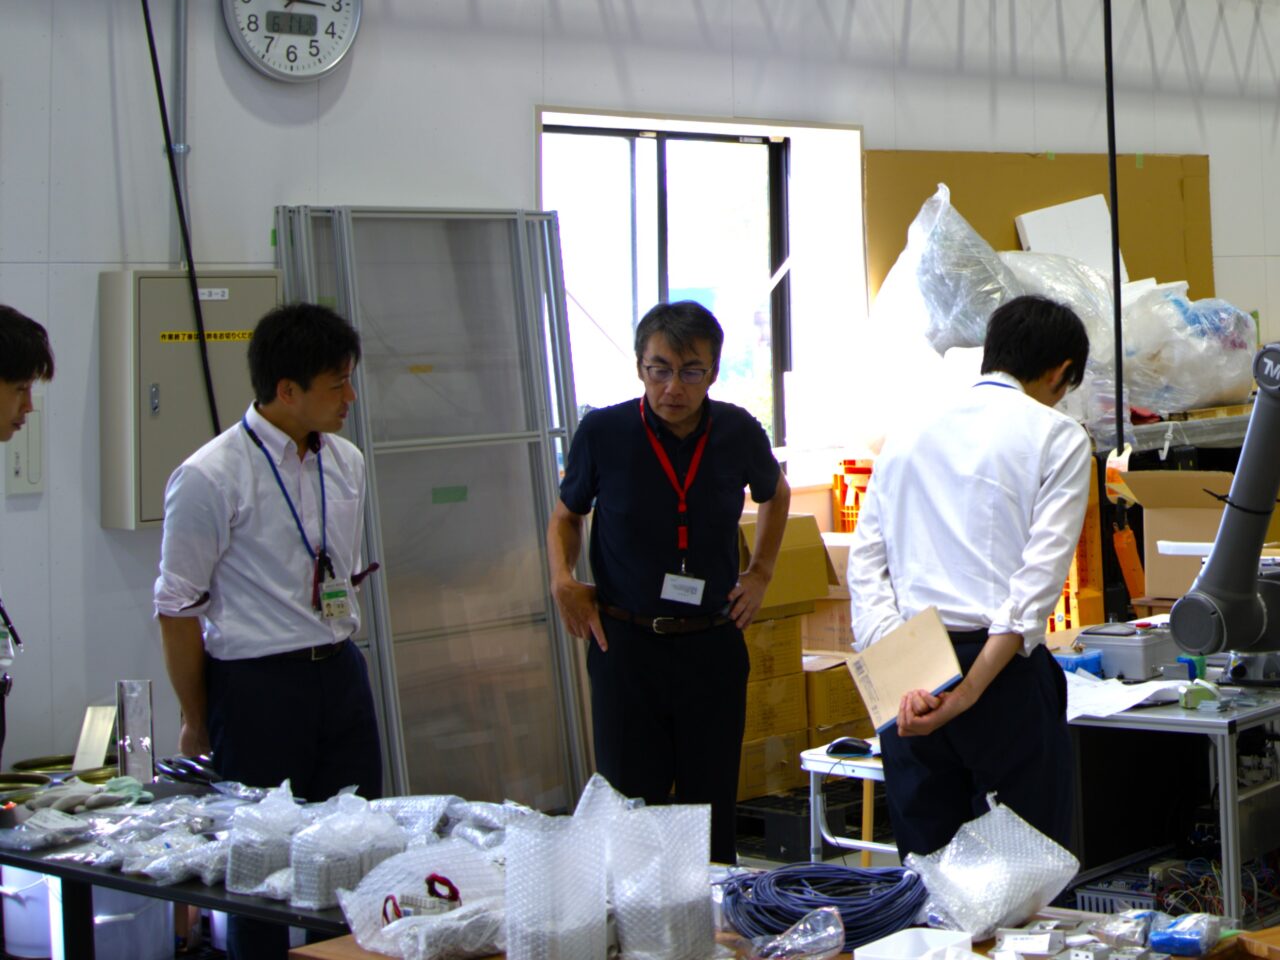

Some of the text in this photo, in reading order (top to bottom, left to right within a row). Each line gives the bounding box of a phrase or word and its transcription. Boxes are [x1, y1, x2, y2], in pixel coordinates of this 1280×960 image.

[247, 14, 259, 32] 8
[325, 21, 337, 39] 4
[264, 36, 275, 54] 7
[286, 45, 298, 63] 6
[309, 40, 320, 57] 5
